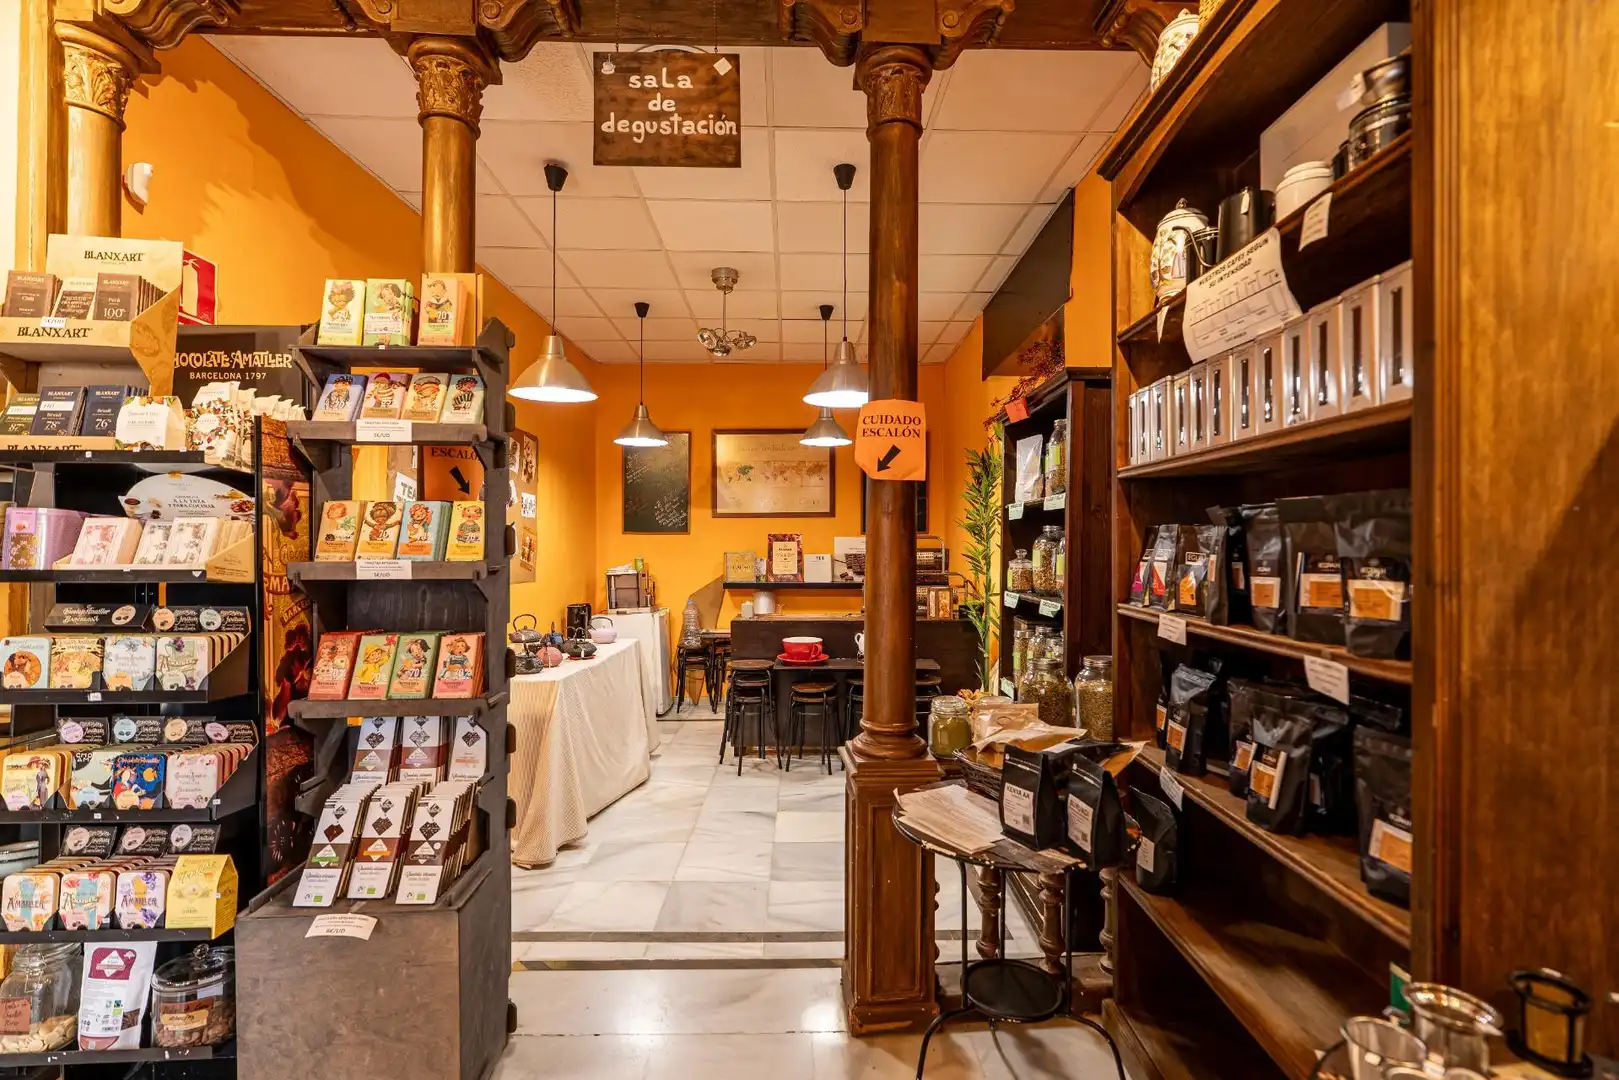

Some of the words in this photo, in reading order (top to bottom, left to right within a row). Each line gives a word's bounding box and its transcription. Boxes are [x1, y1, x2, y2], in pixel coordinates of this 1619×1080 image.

[648, 92, 676, 112] de
[601, 112, 737, 144] degustación
[84, 250, 144, 262] BLANXART
[17, 326, 90, 338] BLANXART
[174, 350, 230, 369] HOCOLATE
[189, 371, 242, 380] BARCELONA
[245, 371, 267, 380] 1797
[862, 414, 922, 426] CUIDADO
[862, 426, 921, 438] ESCALÓN
[431, 447, 479, 461] ESCALO
[1006, 786, 1022, 796] KENYA
